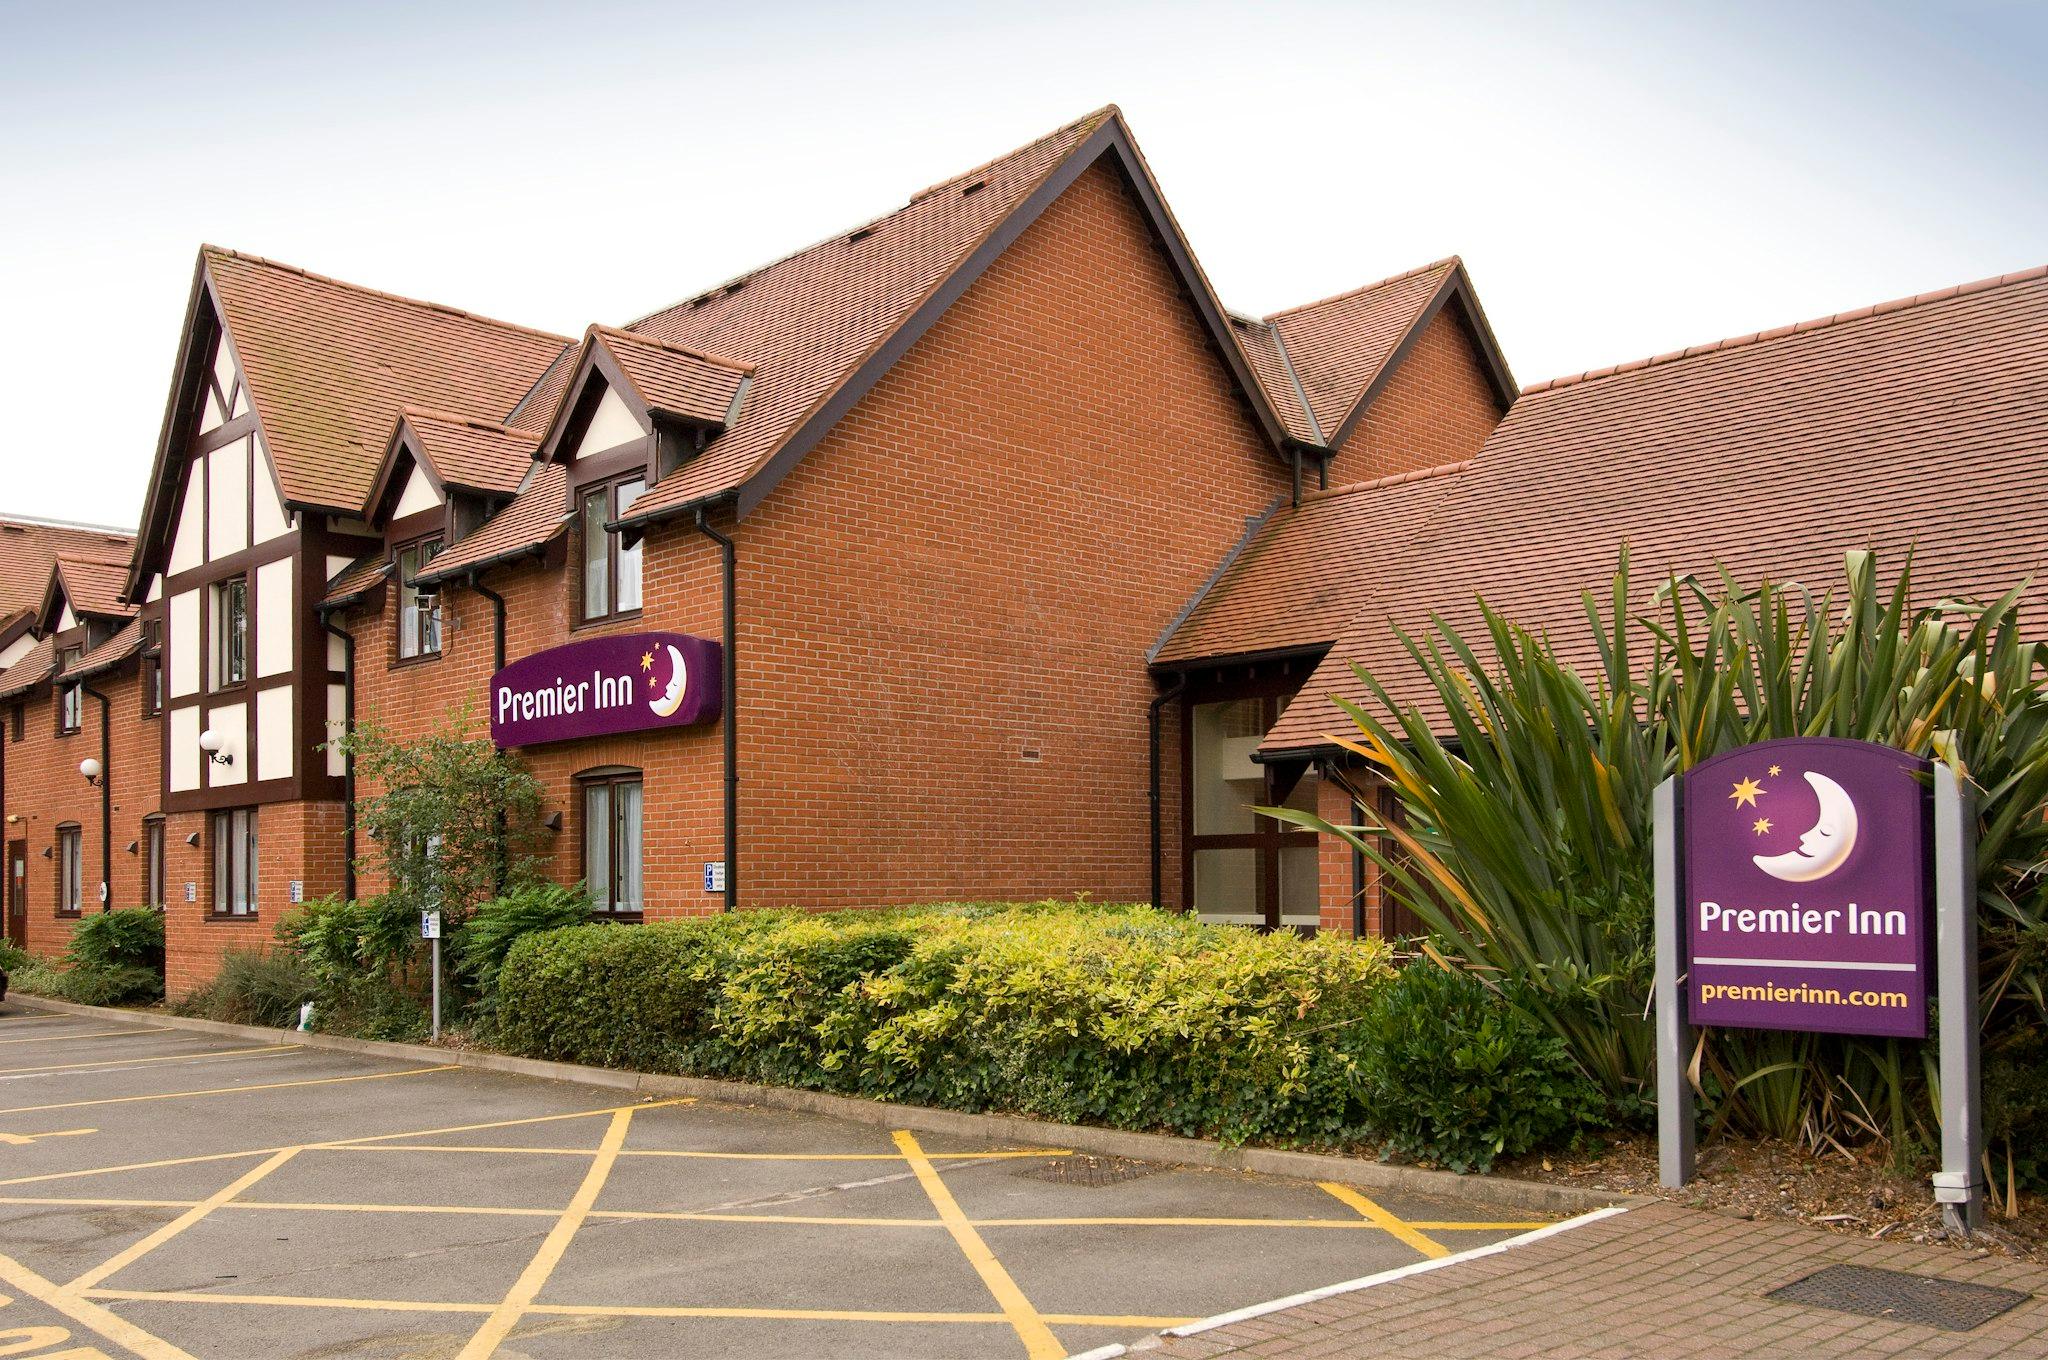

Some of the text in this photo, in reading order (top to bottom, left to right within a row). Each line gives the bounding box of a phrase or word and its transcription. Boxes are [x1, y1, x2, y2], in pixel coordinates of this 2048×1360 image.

[498, 670, 633, 725] Premier Inn
[1700, 902, 1906, 935] Premier Inn
[1701, 981, 1908, 1008] premierinn.com
